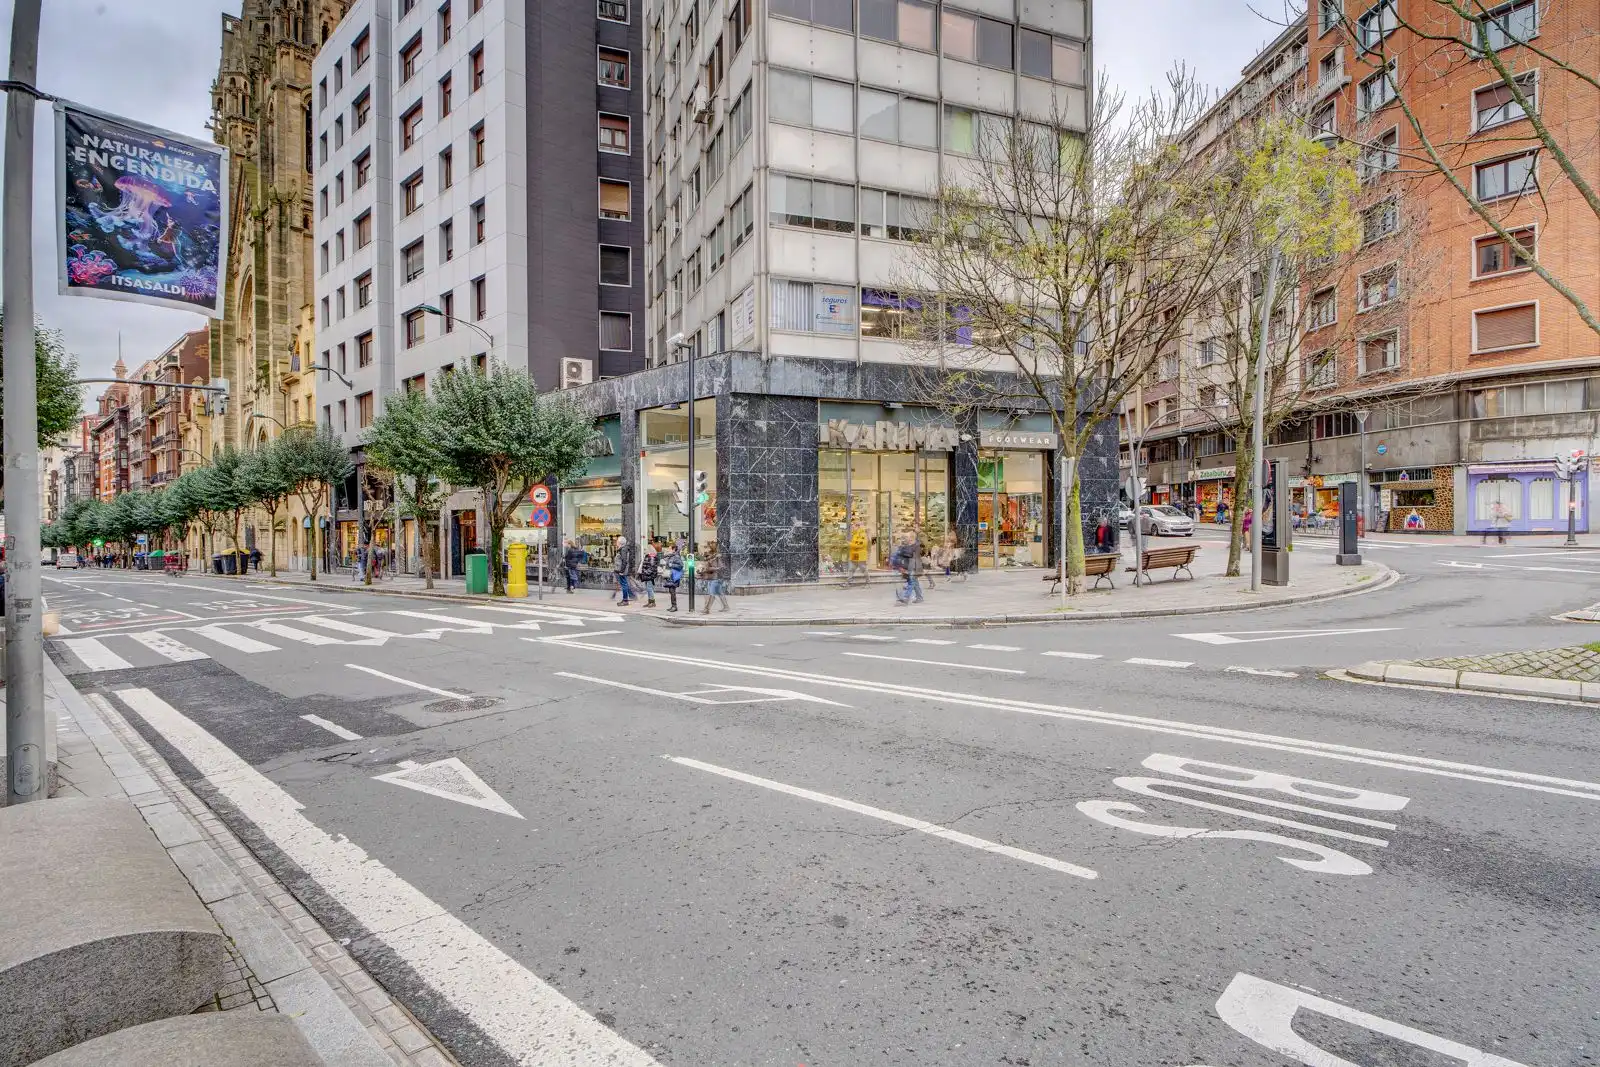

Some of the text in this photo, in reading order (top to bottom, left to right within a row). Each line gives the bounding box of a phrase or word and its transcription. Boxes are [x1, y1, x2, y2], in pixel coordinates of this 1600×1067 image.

[74, 146, 217, 194] ENCENDIDA
[82, 133, 207, 176] NATURALEZA
[111, 274, 186, 296] ITSASALDI
[988, 435, 1050, 445] FOOTWEAR
[1075, 753, 1411, 876] BUS
